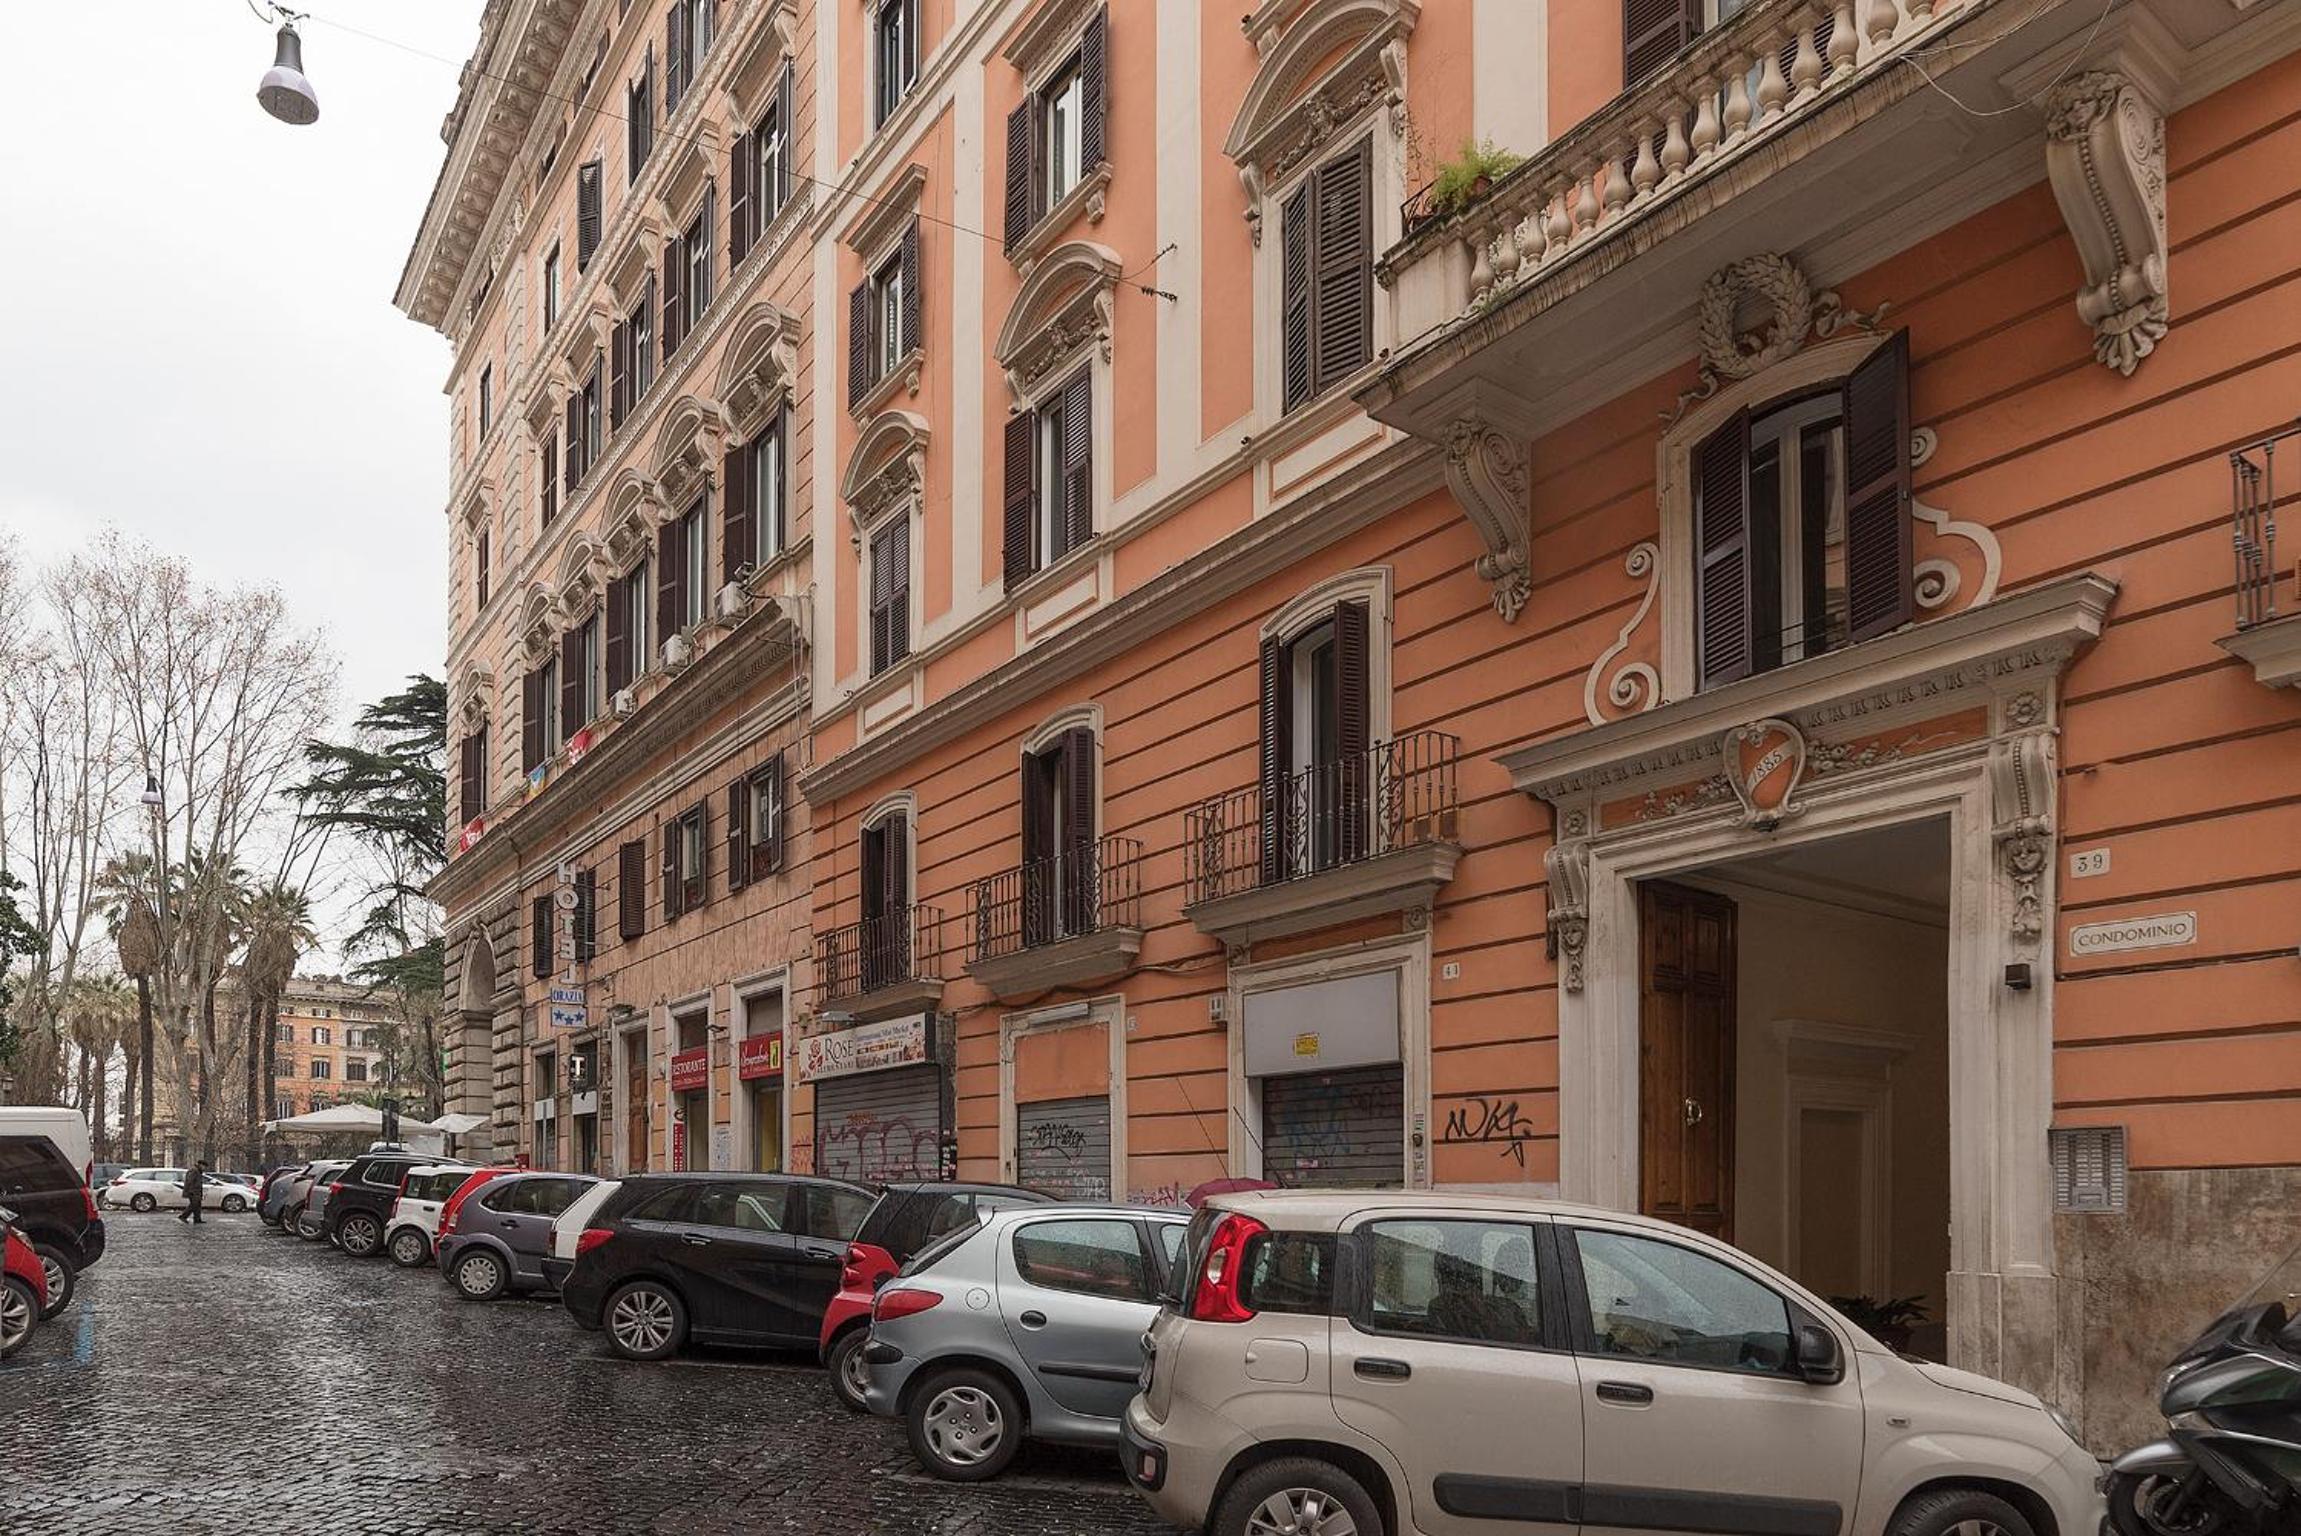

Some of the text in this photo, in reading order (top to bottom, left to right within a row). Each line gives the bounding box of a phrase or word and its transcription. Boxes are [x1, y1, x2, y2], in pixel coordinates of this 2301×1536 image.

[2078, 854, 2103, 873] 39
[2078, 922, 2187, 947] CONDOMINIO
[825, 1038, 853, 1063] ROSE
